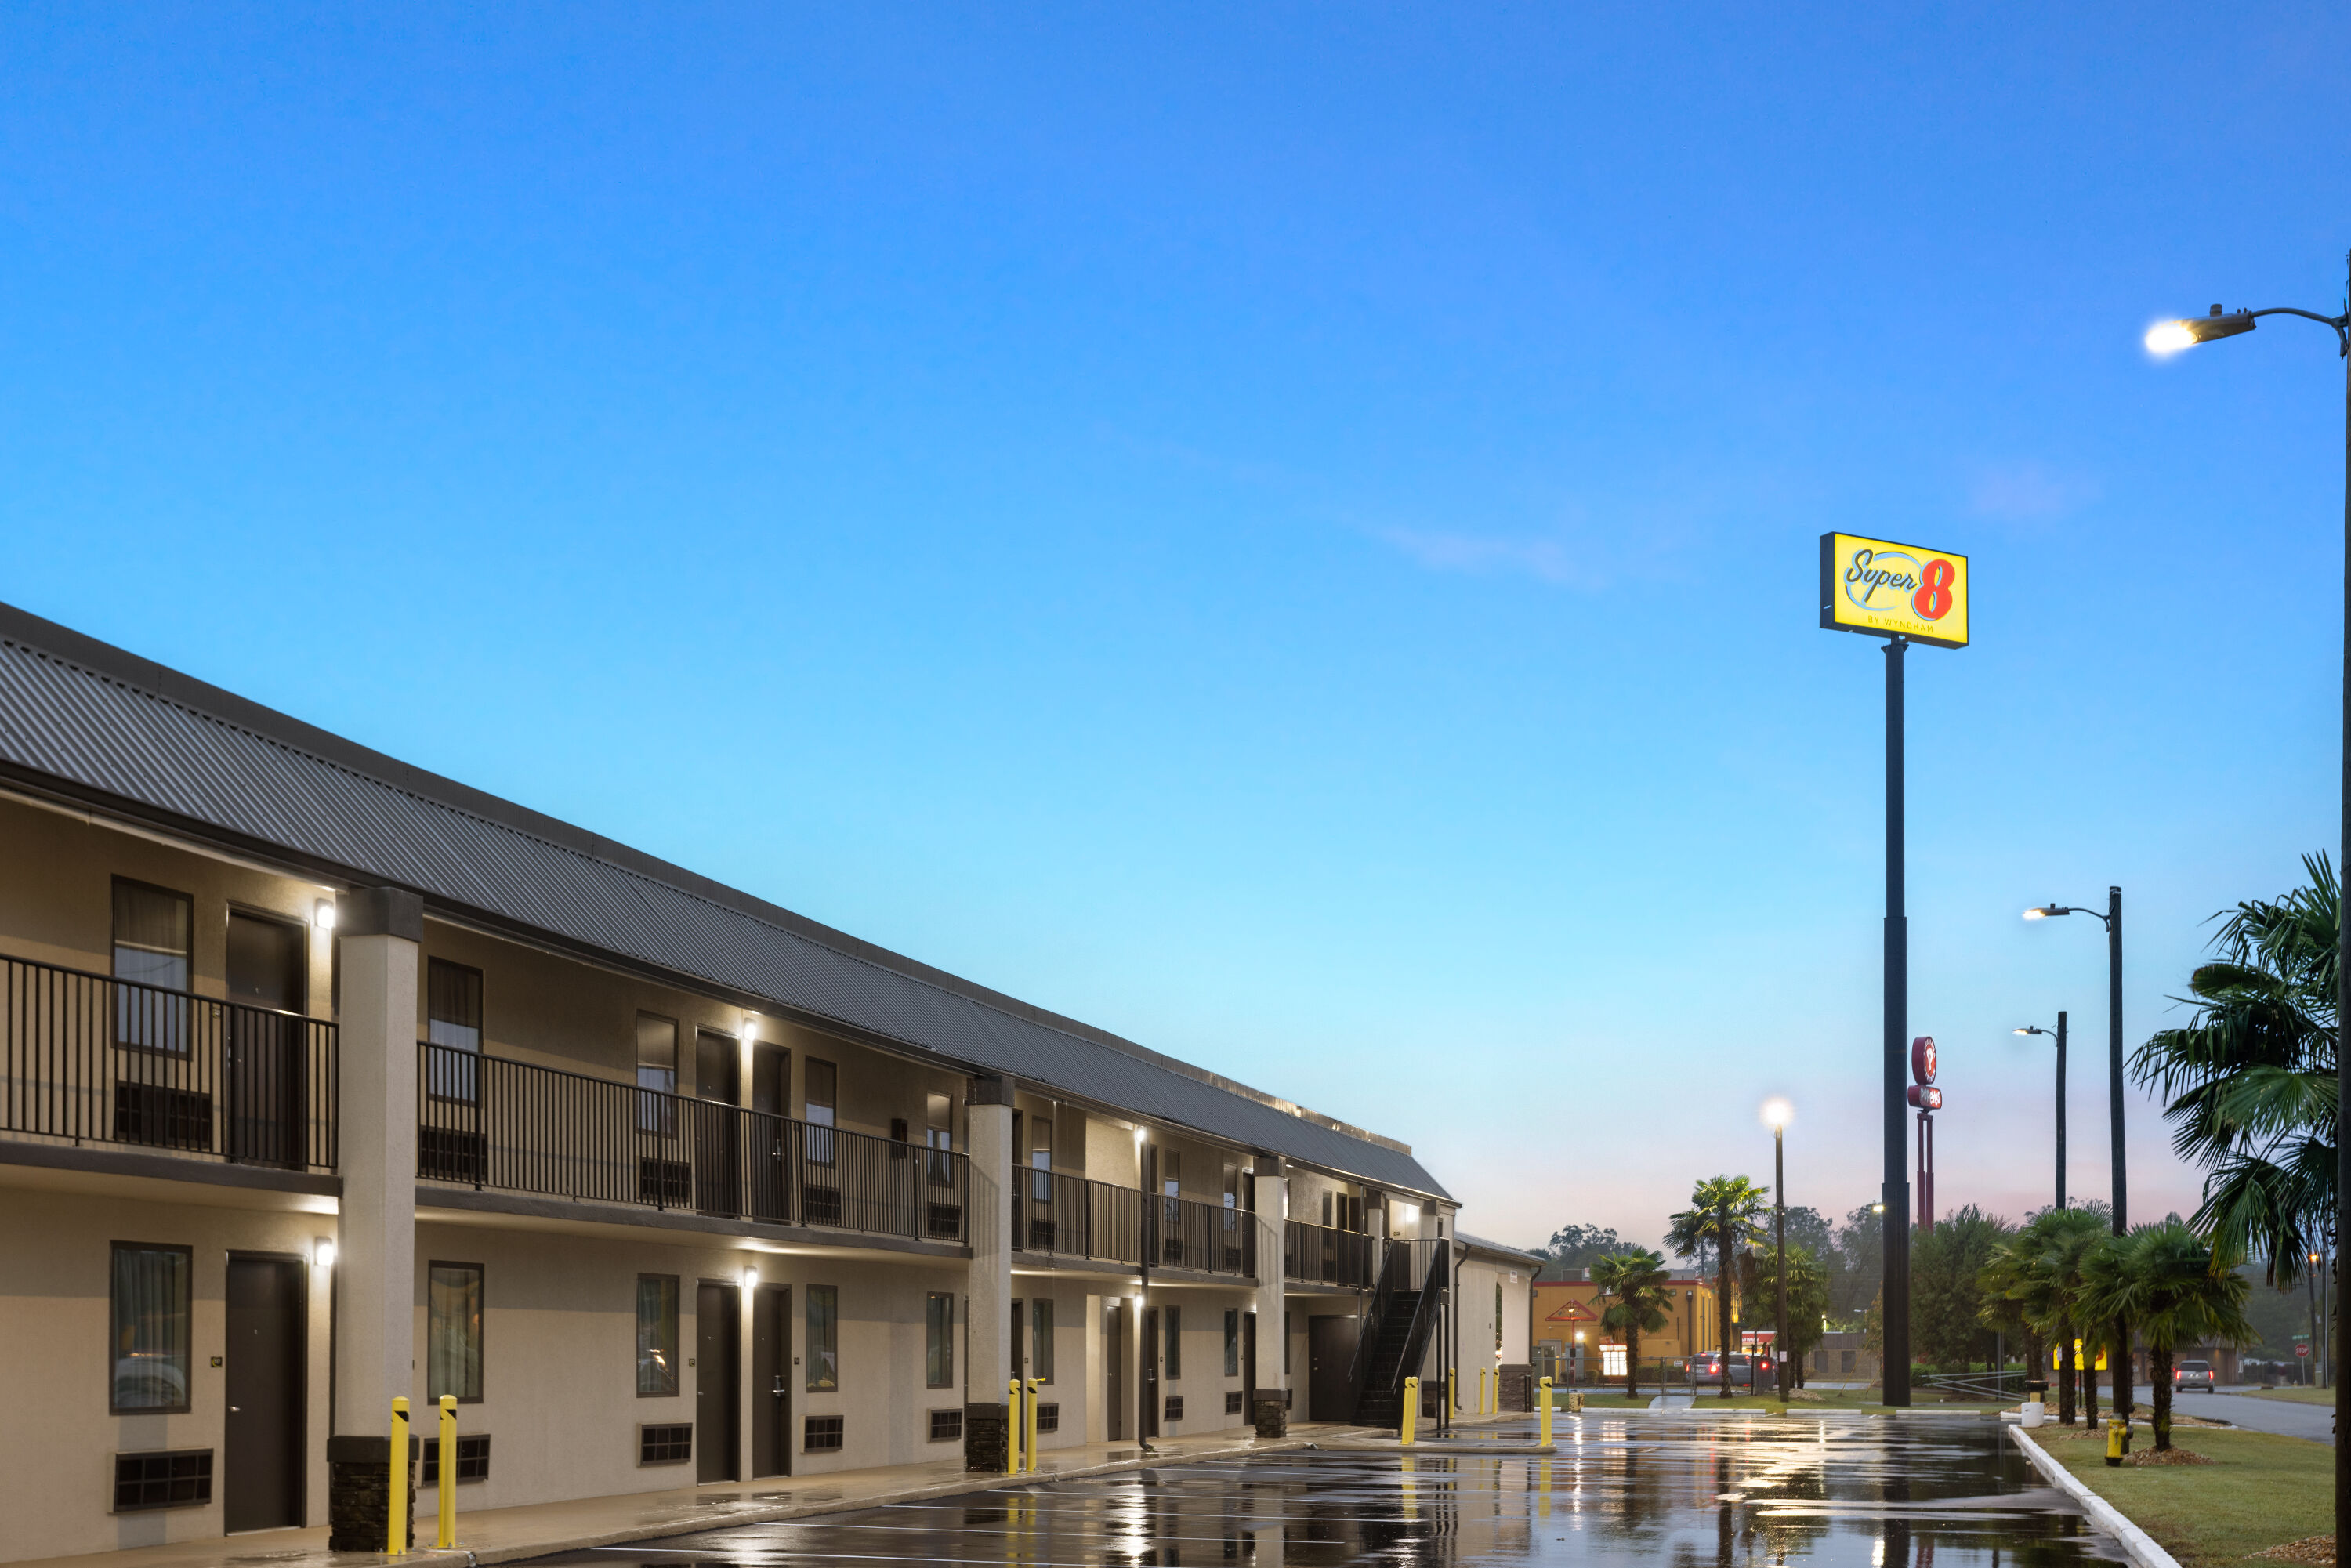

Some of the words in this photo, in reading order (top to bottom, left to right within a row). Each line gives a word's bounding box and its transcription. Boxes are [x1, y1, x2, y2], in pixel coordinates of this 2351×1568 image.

[1844, 549, 1917, 603] Super
[1911, 559, 1955, 621] 8
[1867, 615, 1879, 624] BY
[1884, 617, 1933, 633] WYNDHAM
